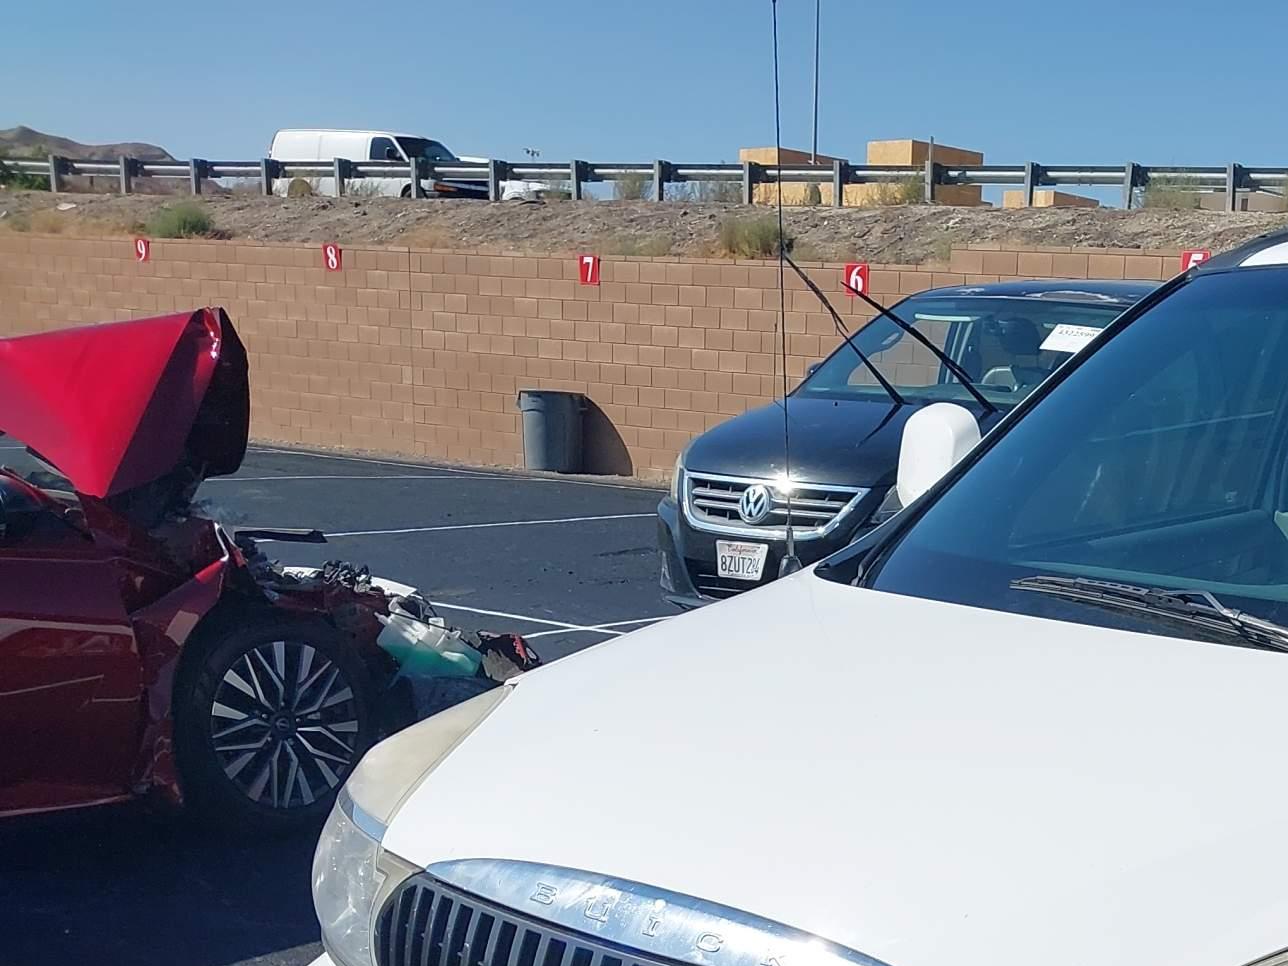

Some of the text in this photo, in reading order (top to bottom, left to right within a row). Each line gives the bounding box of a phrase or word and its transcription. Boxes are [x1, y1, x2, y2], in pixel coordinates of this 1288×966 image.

[136, 240, 146, 261] 9
[326, 246, 337, 269] 8
[582, 256, 594, 282] 7
[850, 266, 863, 292] 6
